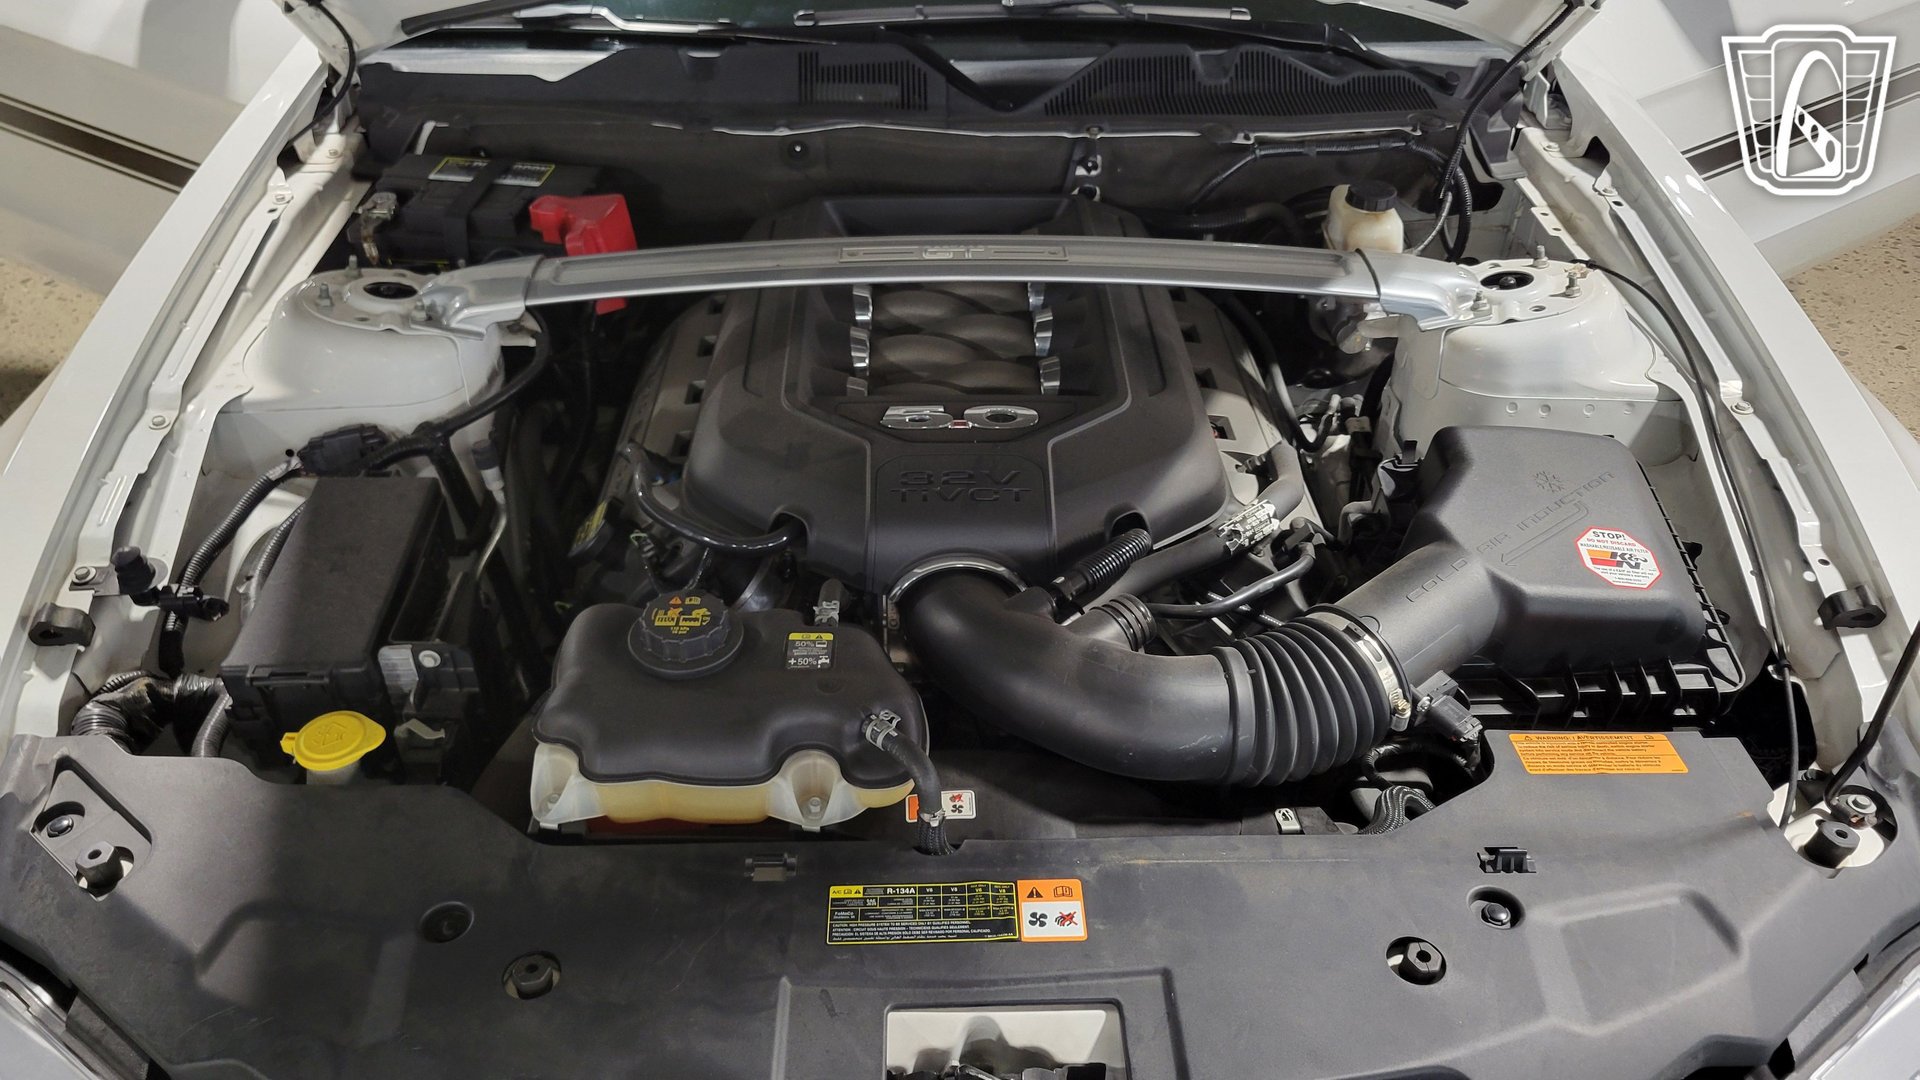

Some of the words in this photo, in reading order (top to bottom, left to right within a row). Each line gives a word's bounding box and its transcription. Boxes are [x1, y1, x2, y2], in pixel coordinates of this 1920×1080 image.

[922, 248, 984, 259] GT
[880, 405, 1038, 429] 5.0
[900, 470, 1020, 486] 32V
[1406, 557, 1468, 602] COLD
[1476, 531, 1511, 554] AIR
[1515, 471, 1616, 532] INDUCTION
[1592, 531, 1626, 540] STOP!
